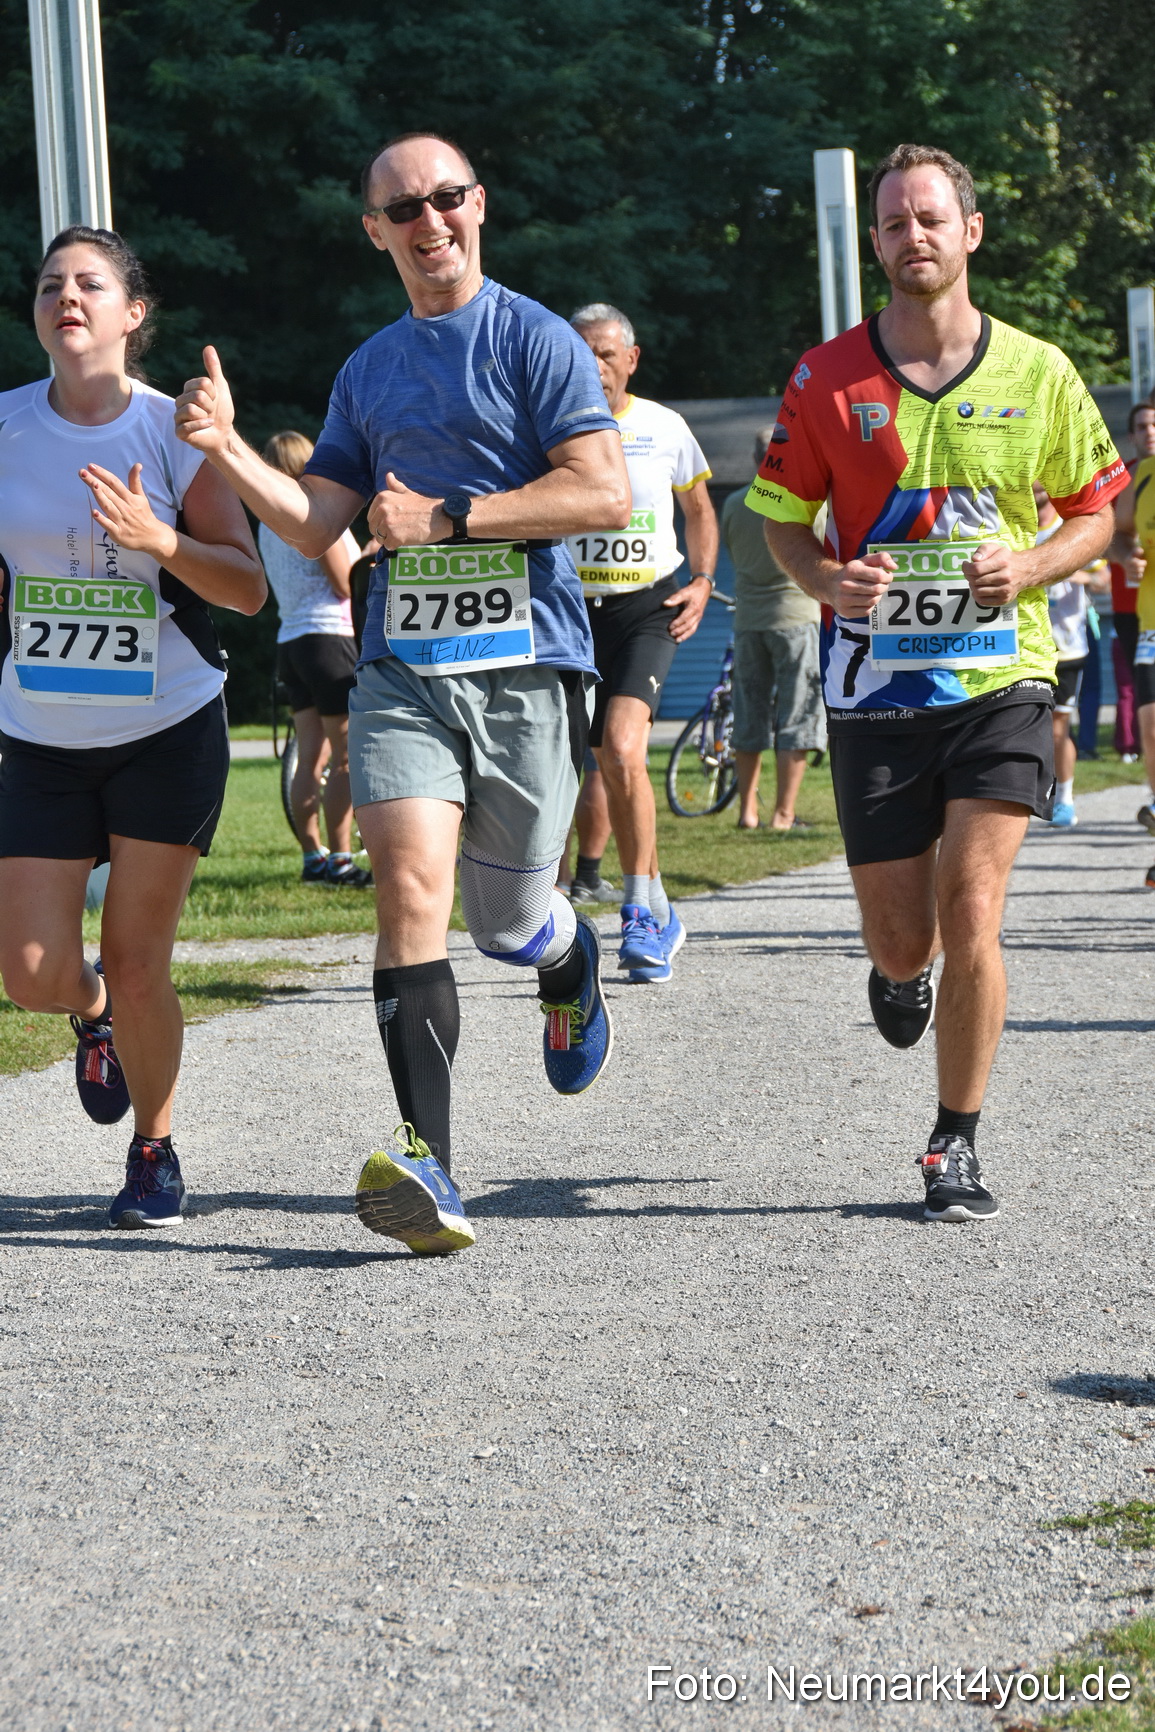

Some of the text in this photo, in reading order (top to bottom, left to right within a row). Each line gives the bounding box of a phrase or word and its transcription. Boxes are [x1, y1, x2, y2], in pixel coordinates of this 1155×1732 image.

[66, 526, 79, 551] Hotel
[575, 537, 647, 563] 1209
[396, 549, 513, 579] BOCK
[580, 570, 641, 582] EDMUND
[890, 549, 977, 577] BOC
[26, 582, 144, 612] BOCK
[399, 587, 513, 631] 2789
[26, 620, 140, 663] 2773
[897, 635, 996, 654] CRISTOPH
